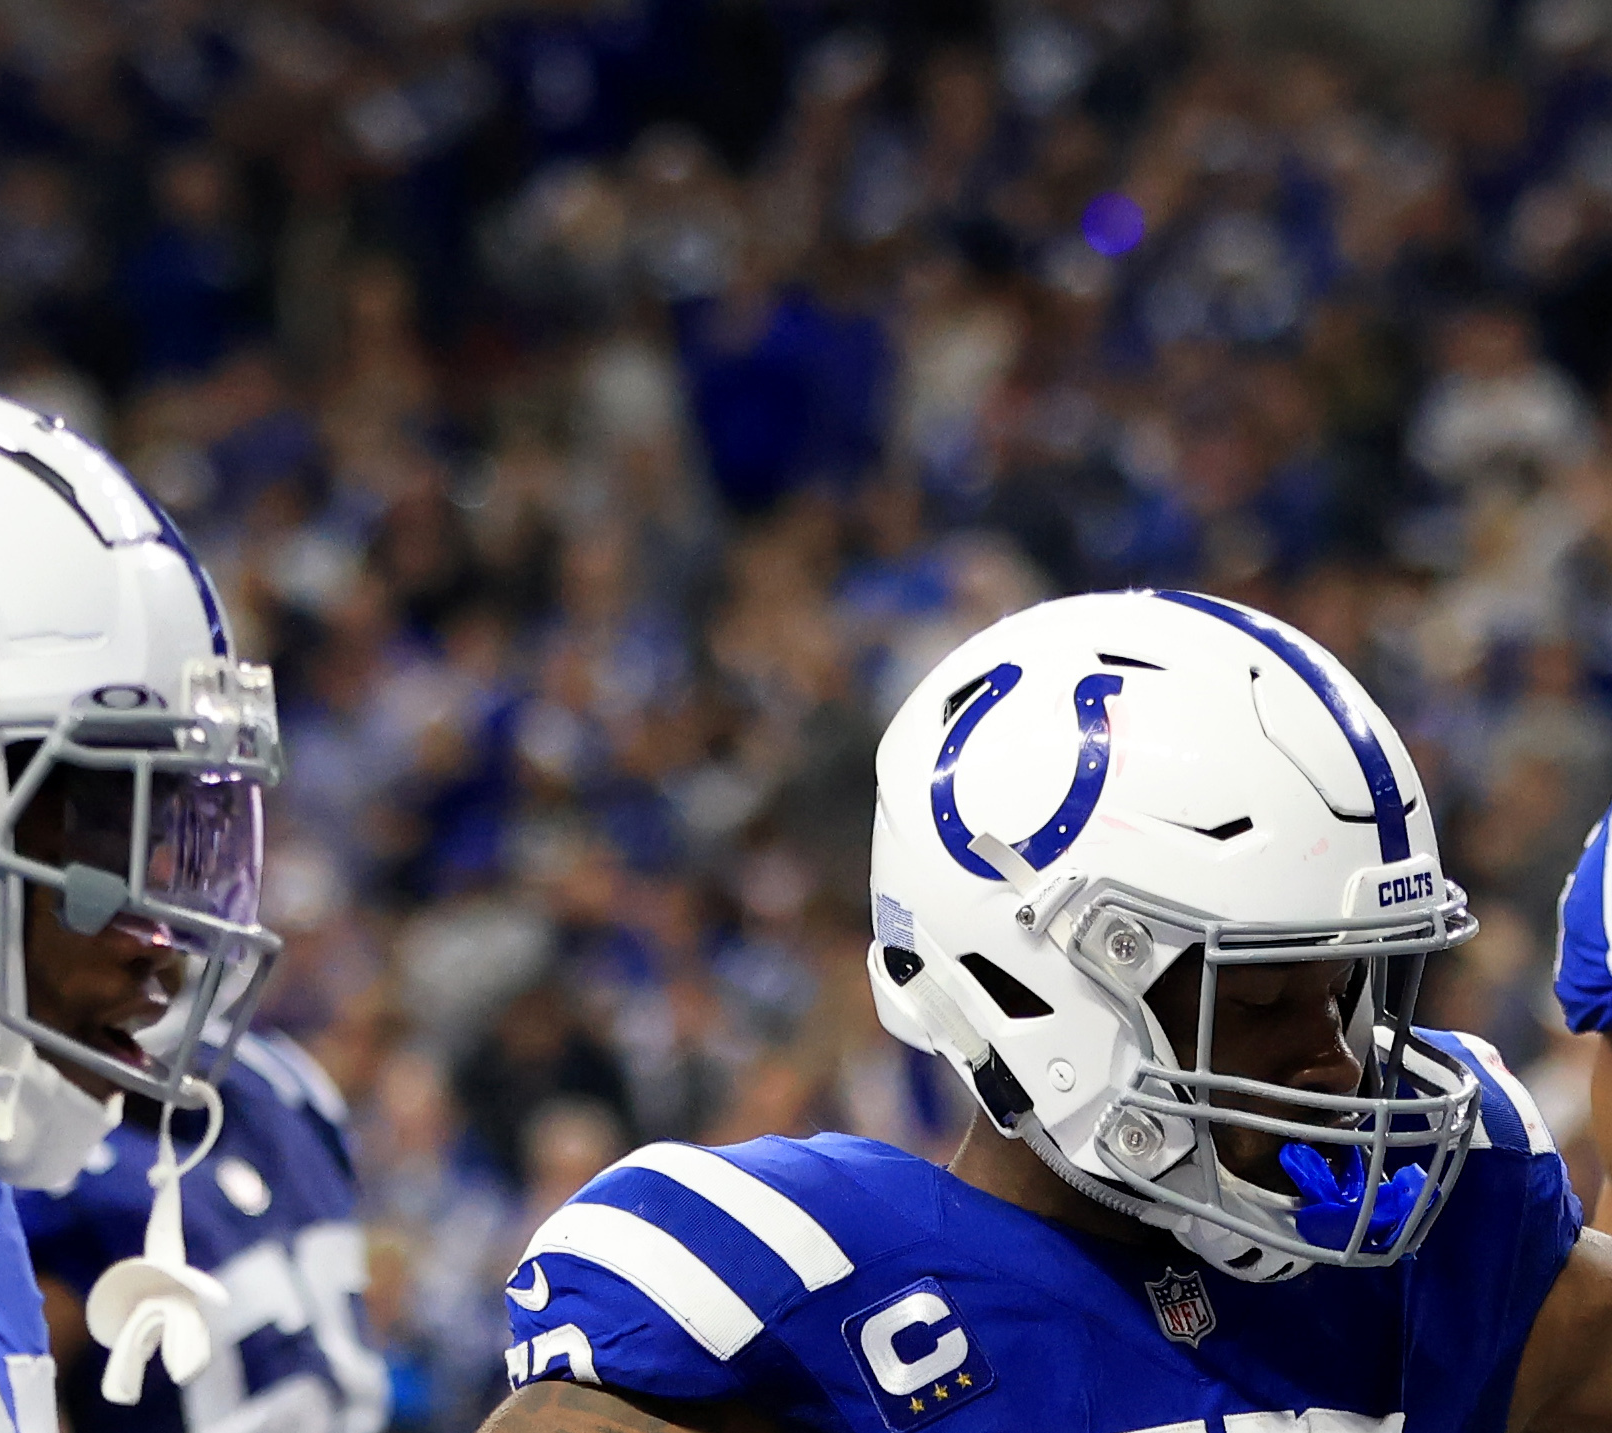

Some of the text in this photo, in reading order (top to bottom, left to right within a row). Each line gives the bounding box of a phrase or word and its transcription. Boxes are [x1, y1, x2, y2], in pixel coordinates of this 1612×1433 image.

[1378, 871, 1433, 908] COLTS
[1164, 1300, 1208, 1333] NFL
[860, 1291, 969, 1396] C
